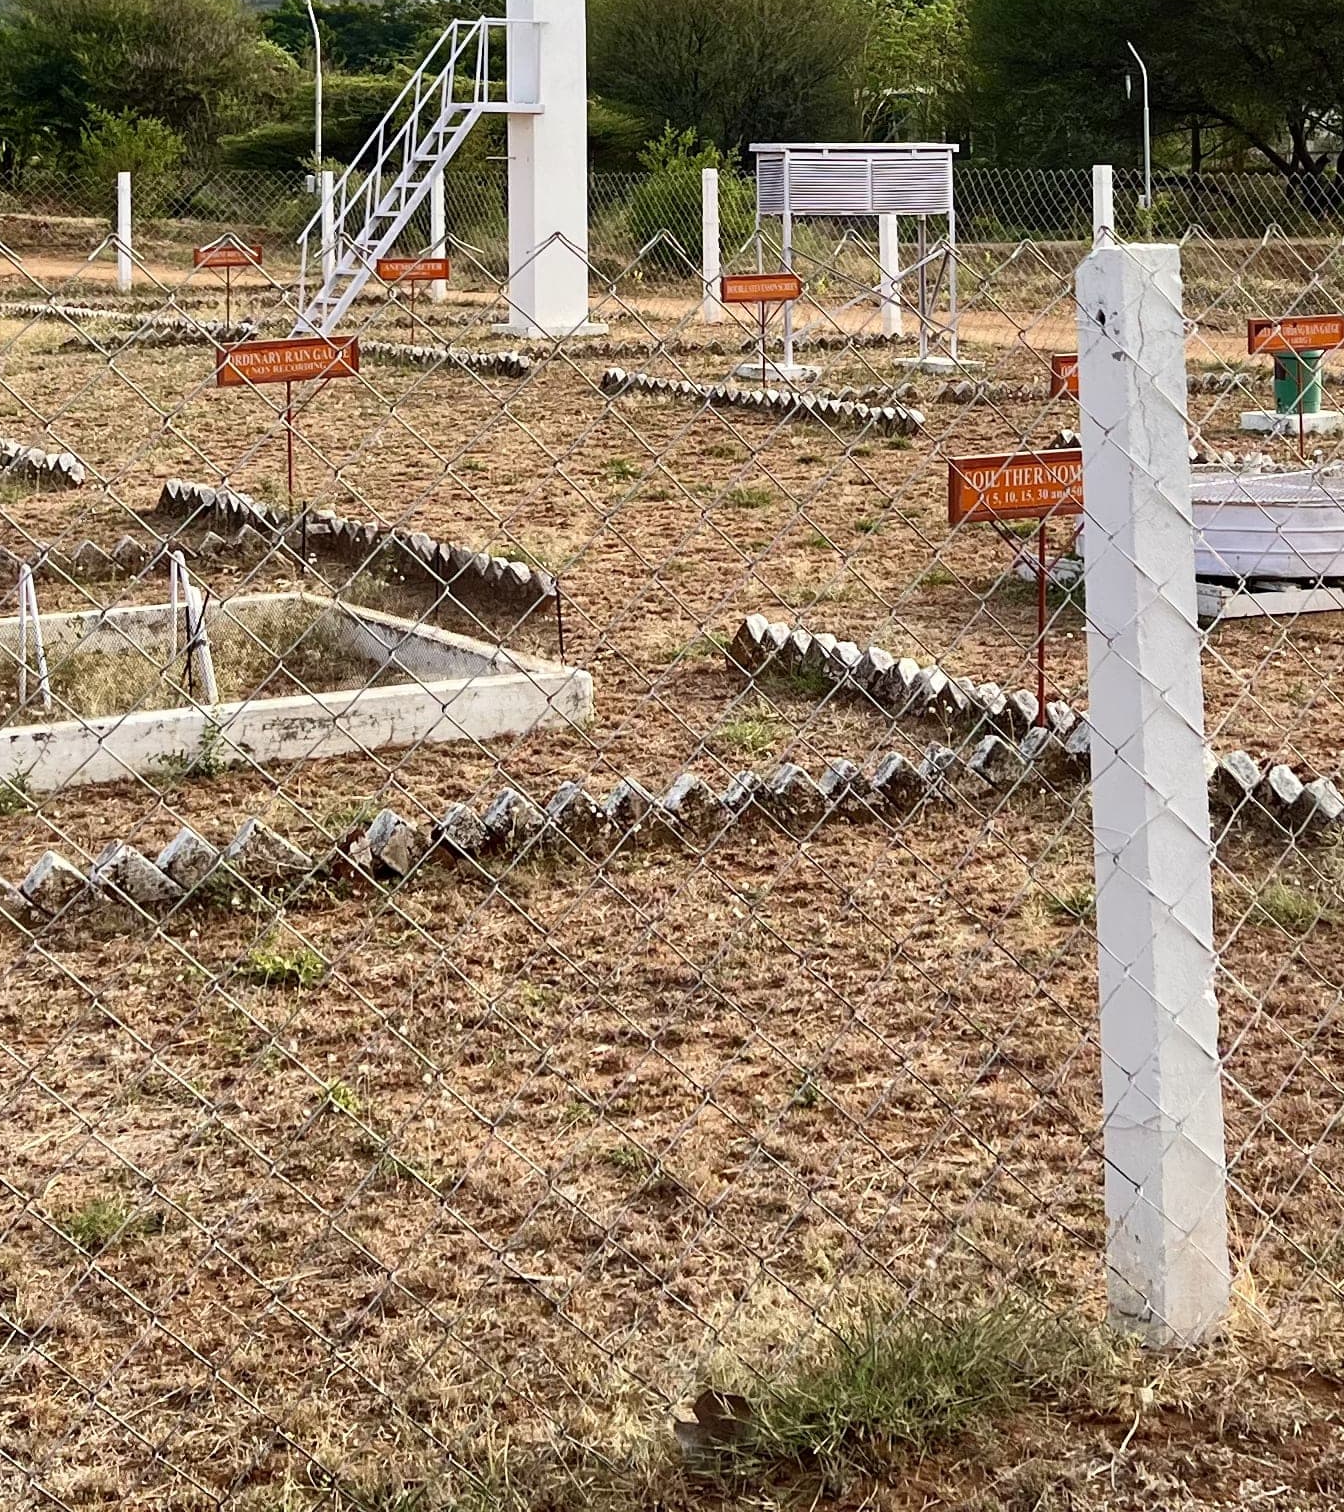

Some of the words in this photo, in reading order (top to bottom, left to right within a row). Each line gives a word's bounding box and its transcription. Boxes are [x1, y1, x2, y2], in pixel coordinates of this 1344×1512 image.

[284, 349, 312, 364] RAIN
[312, 347, 350, 361] GAUE
[963, 470, 1001, 490] SOIL
[1036, 488, 1049, 501] 30
